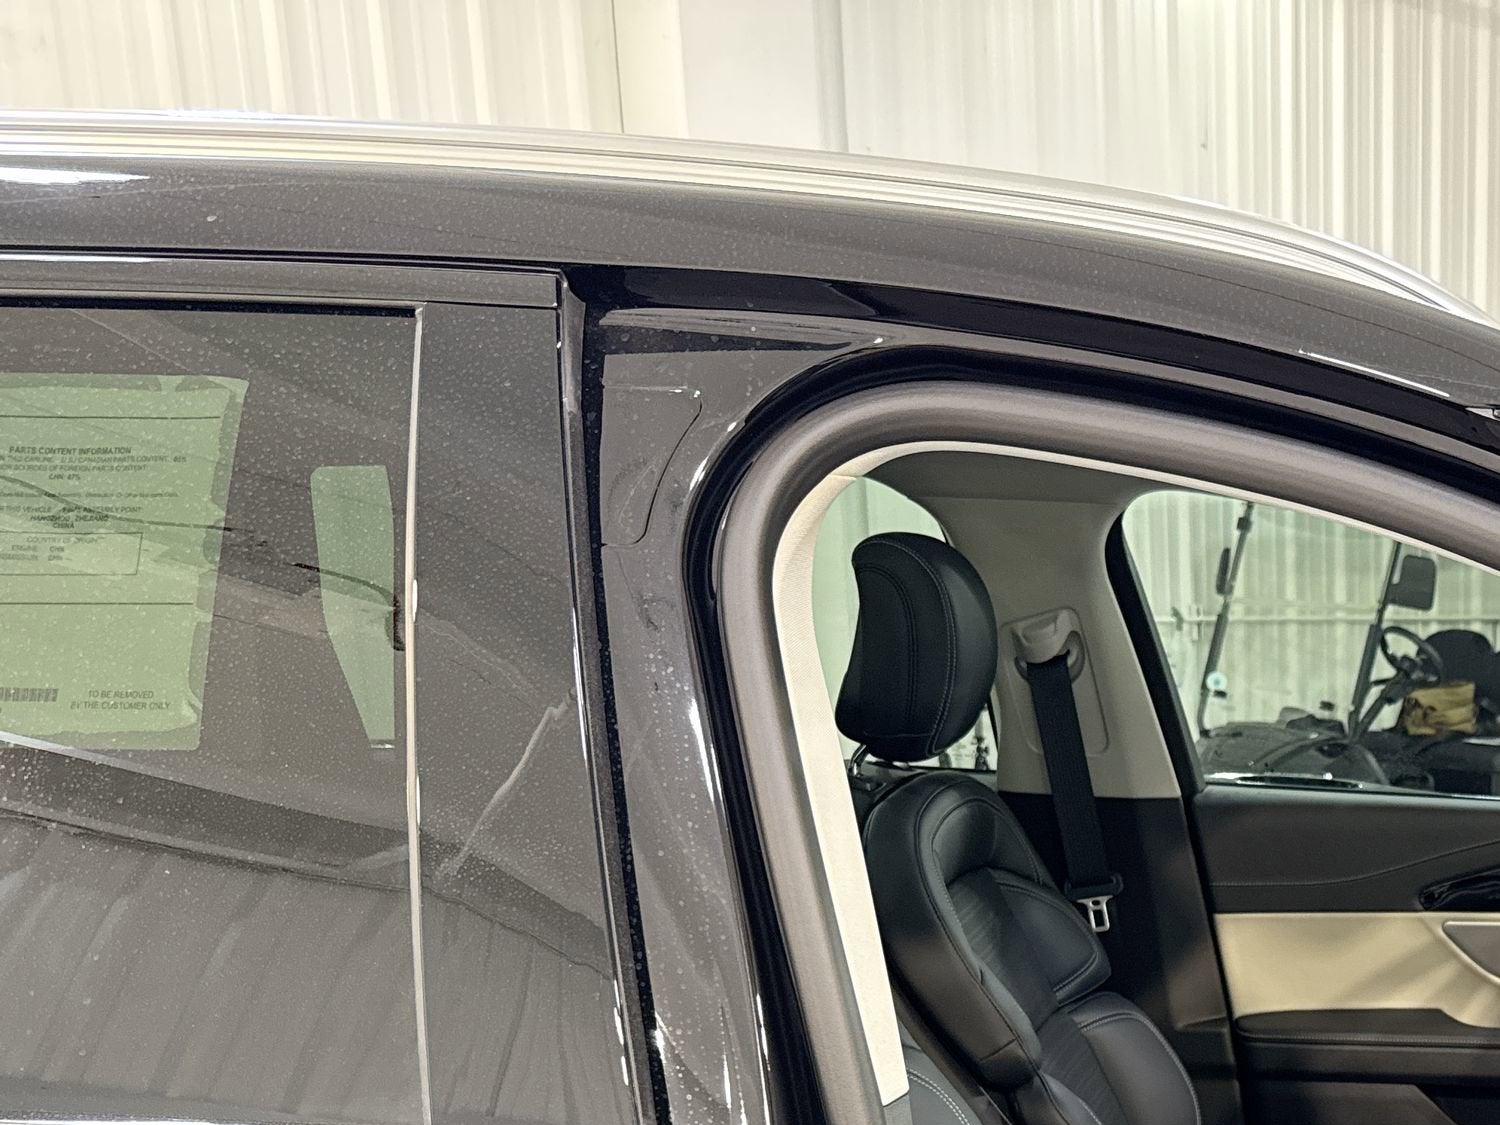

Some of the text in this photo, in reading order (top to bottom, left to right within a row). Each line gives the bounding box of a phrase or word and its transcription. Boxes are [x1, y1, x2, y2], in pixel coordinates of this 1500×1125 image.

[9, 446, 132, 455] PARTS CONTENT INFORMATION
[88, 689, 154, 699] TO BE REMOVED
[84, 701, 99, 709] THE
[101, 701, 147, 710] CUSTOMER
[149, 701, 170, 710] ONLY
